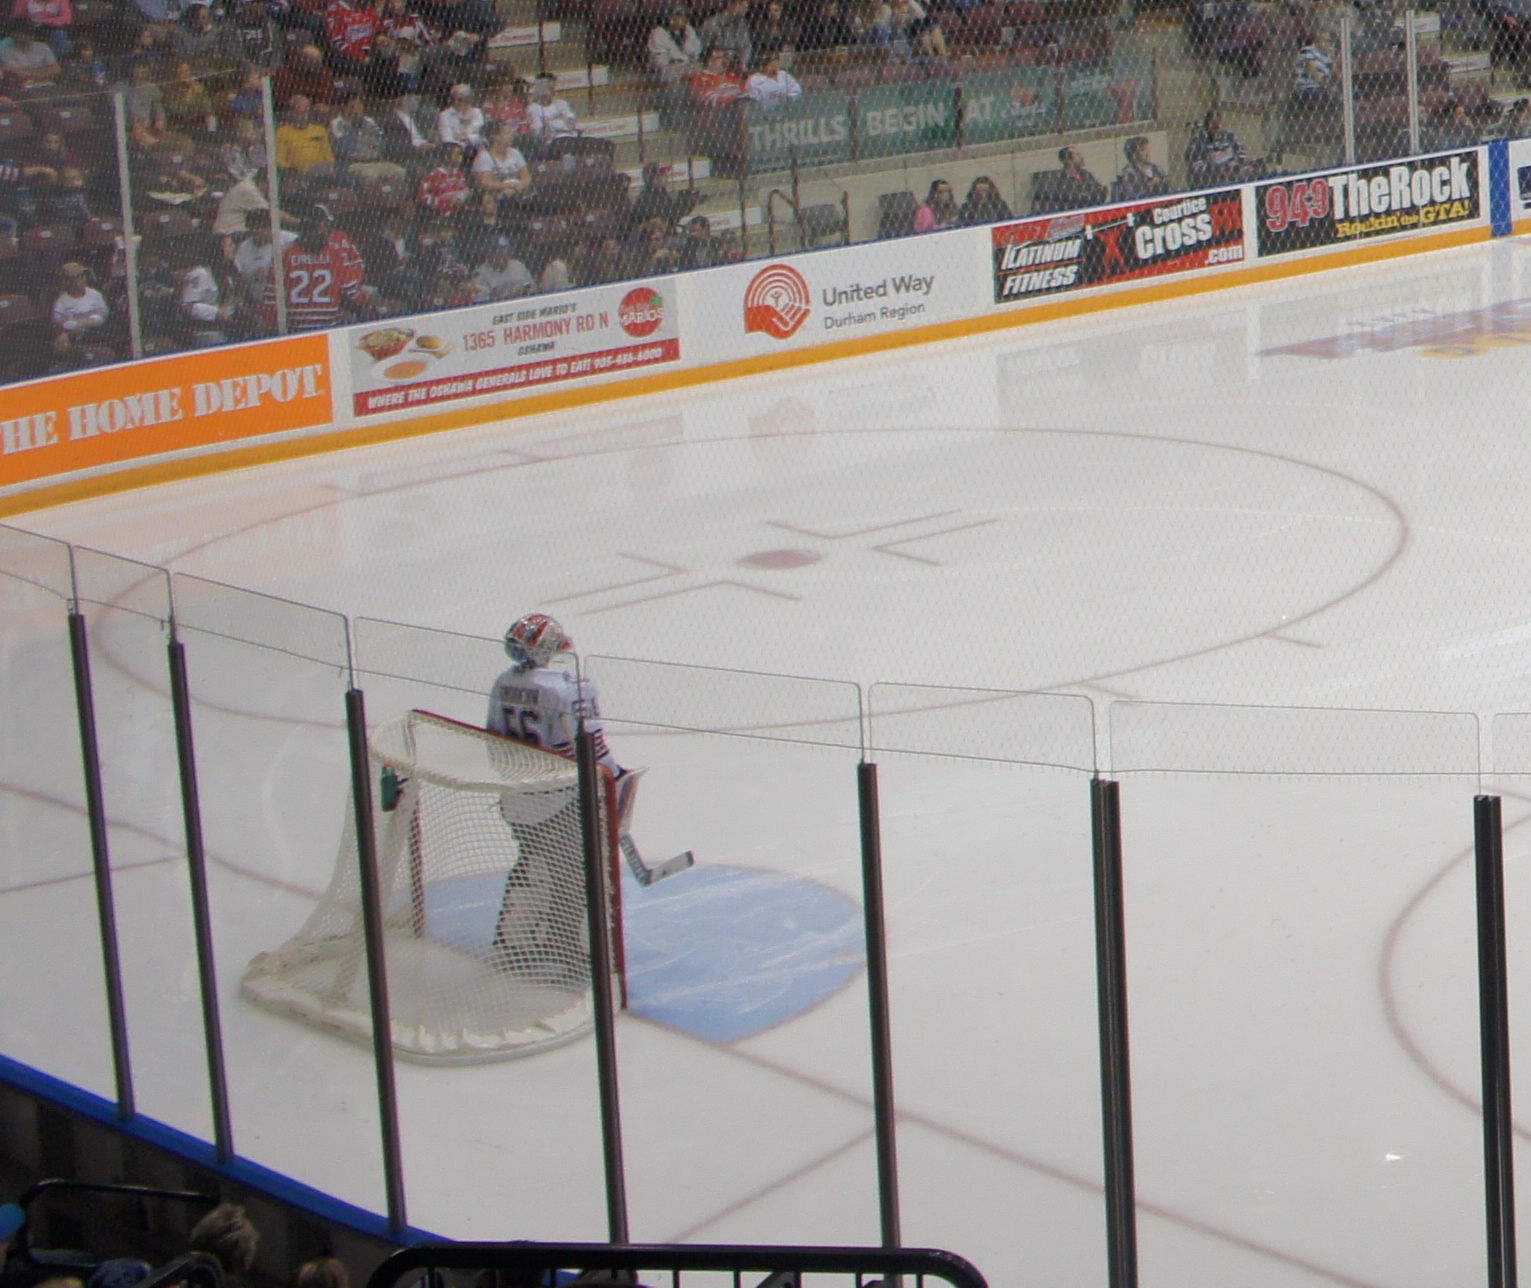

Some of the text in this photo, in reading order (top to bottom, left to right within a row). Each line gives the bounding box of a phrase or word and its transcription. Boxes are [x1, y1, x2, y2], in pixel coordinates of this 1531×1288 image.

[747, 115, 849, 150] THRILLS
[865, 104, 945, 136] BEGIN
[966, 97, 996, 123] AT
[1328, 157, 1472, 221] TheRock
[1152, 196, 1208, 226] Courtice
[1133, 213, 1213, 262] Cross
[1203, 243, 1246, 268] .com
[289, 268, 334, 305] 22
[821, 272, 935, 309] United Way
[1002, 264, 1079, 298] FITNESS
[461, 311, 609, 353] 1365 HARMONY RD N
[823, 302, 926, 331] Durham Region
[0, 364, 324, 455] HE HOME DEPOT
